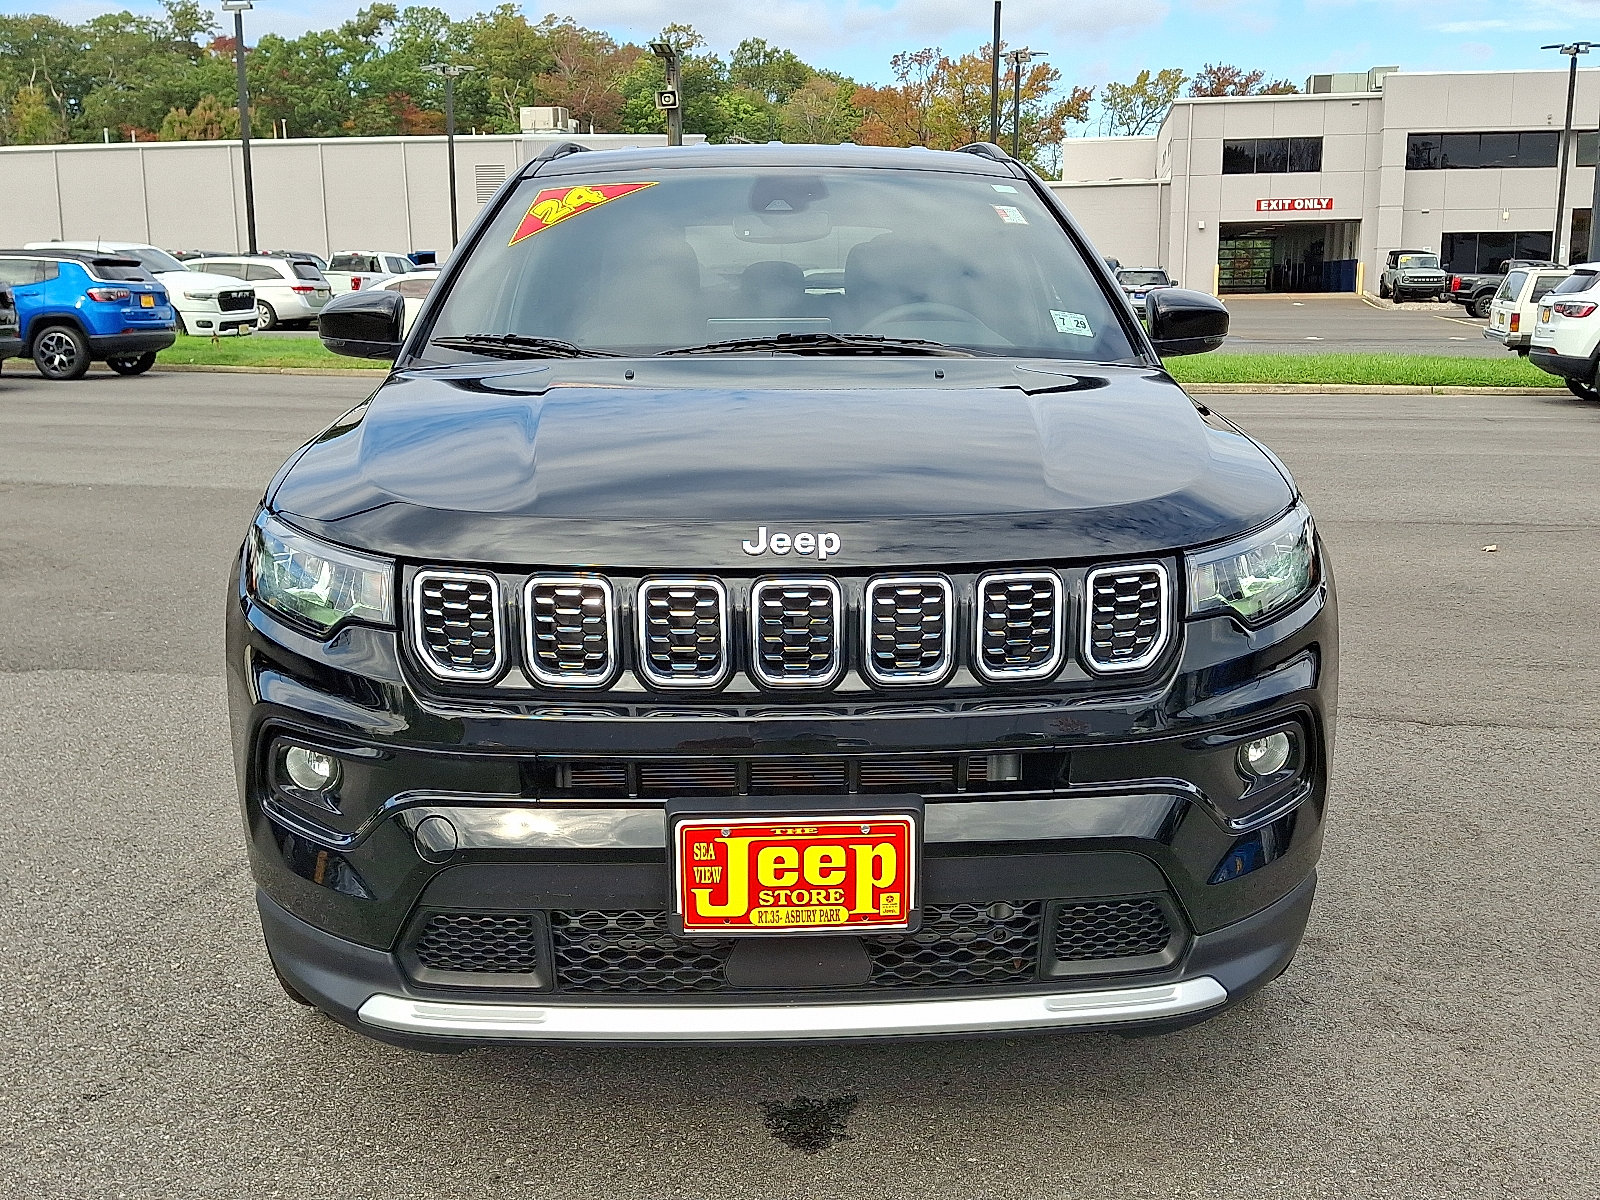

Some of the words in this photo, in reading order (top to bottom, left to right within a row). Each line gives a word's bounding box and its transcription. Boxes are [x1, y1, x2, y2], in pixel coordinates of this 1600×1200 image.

[1260, 199, 1291, 211] EXIT
[1294, 198, 1329, 210] ONLY
[1058, 316, 1066, 326] 7
[1073, 319, 1087, 329] 29
[741, 526, 841, 561] Jeep
[770, 827, 819, 835] THE
[693, 842, 716, 861] SEA
[690, 833, 898, 918] Jeep
[693, 866, 723, 884] VIEW
[758, 888, 845, 906] STORE
[784, 909, 818, 923] ASBURY
[819, 908, 841, 922] PARK
